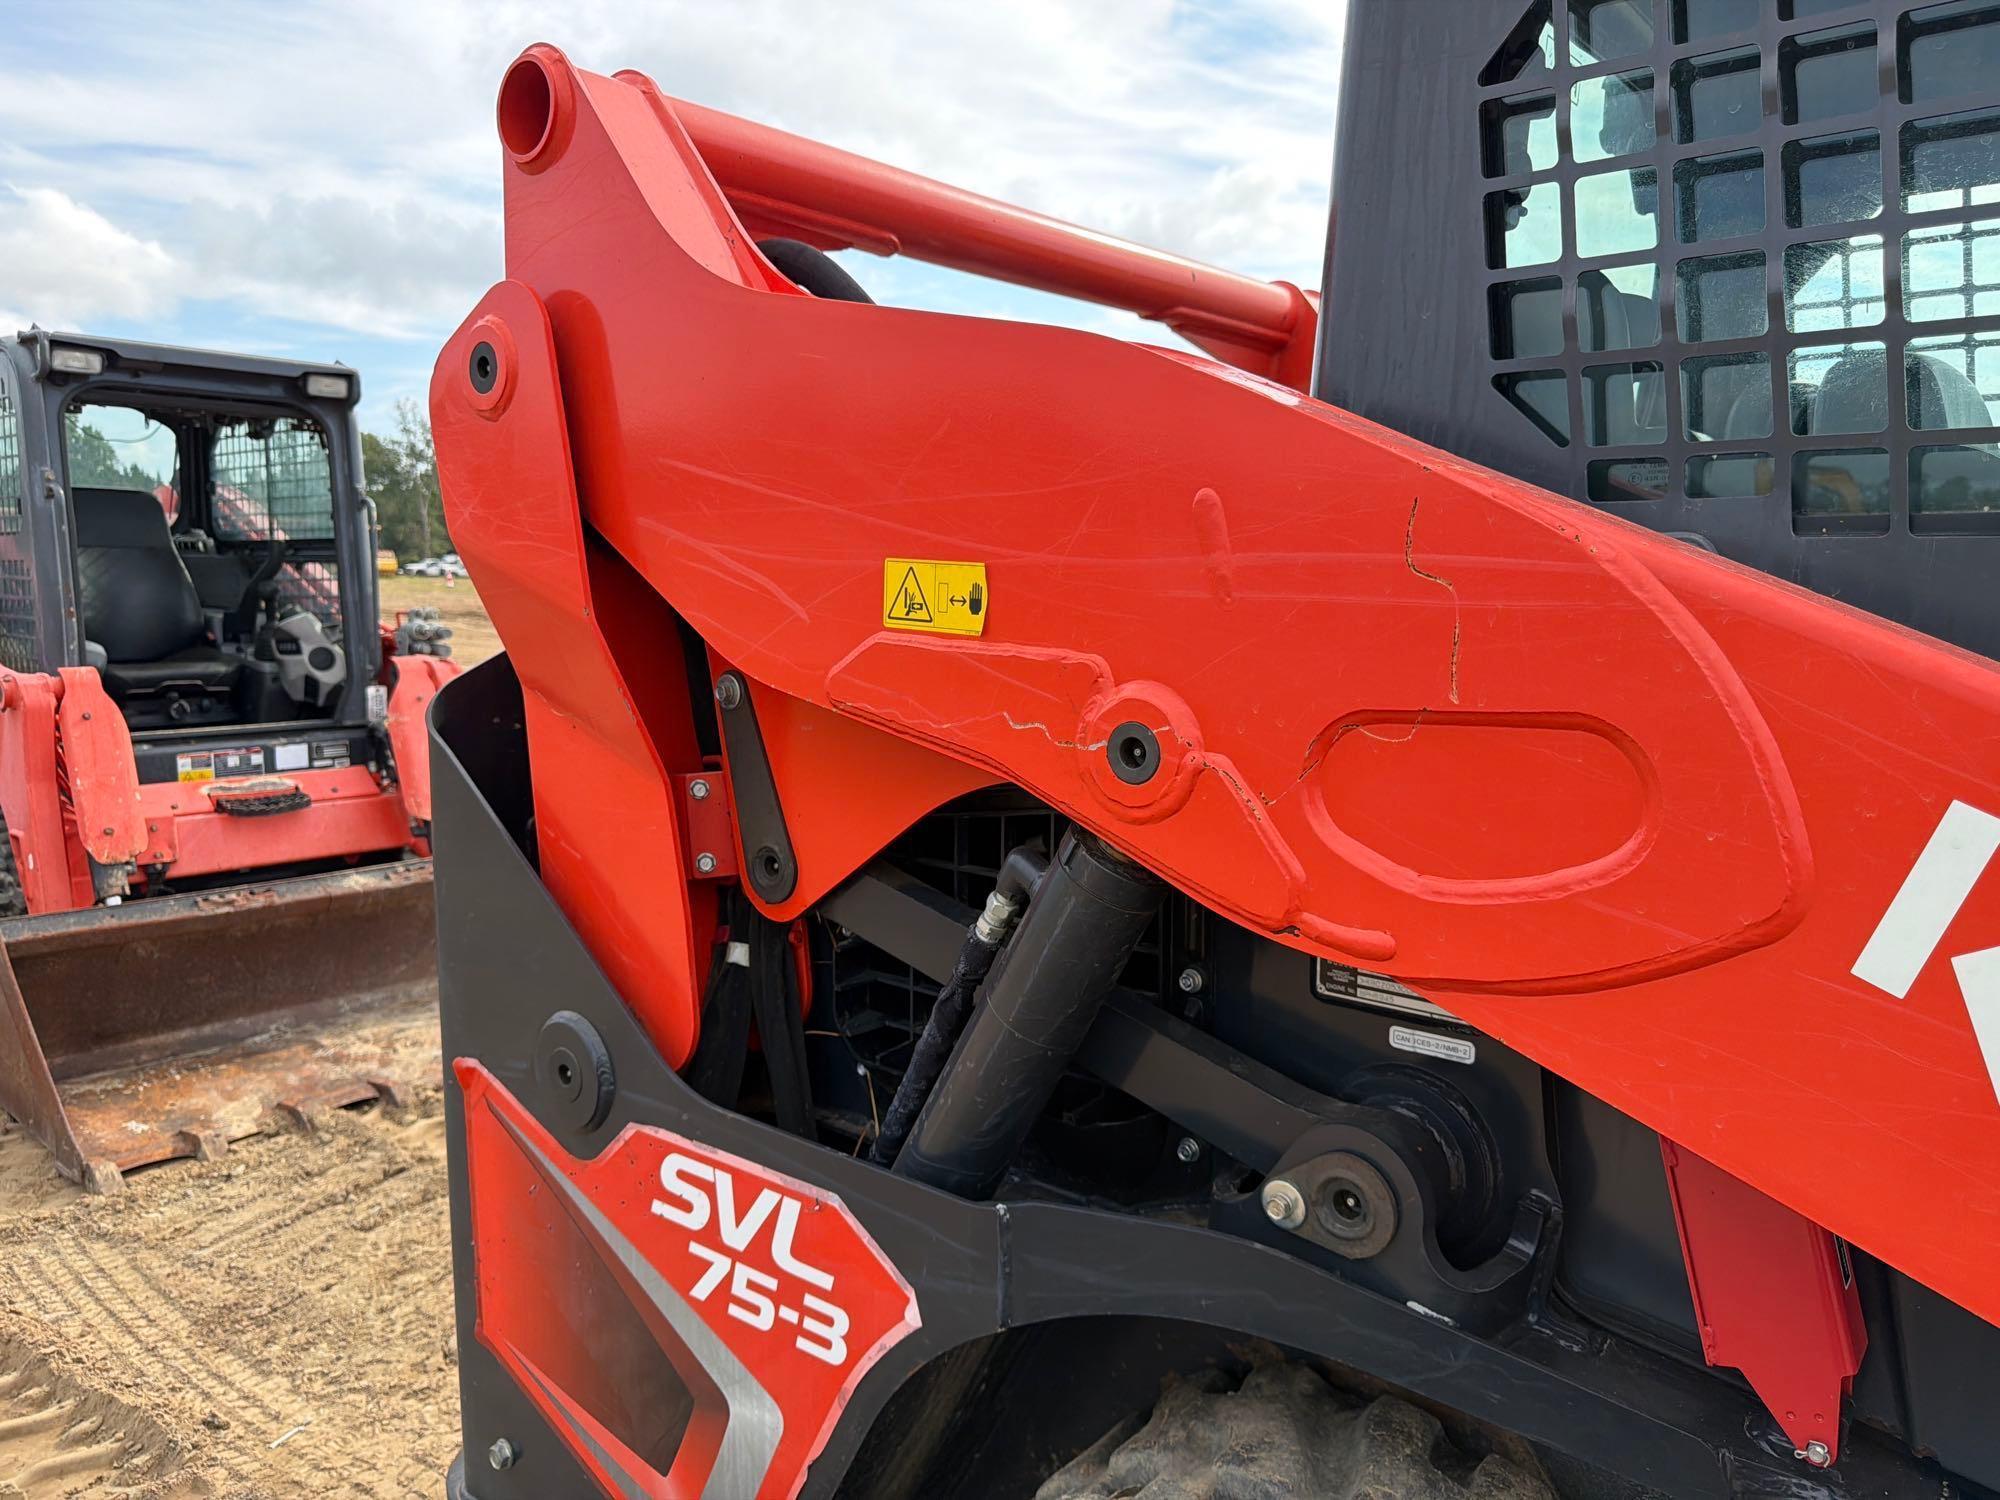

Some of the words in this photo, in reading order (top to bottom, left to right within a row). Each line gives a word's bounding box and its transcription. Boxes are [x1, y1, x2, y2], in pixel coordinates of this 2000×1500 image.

[1395, 1033, 1411, 1044] CAN
[651, 1152, 835, 1292] SVL
[688, 1240, 850, 1366] 75-3
